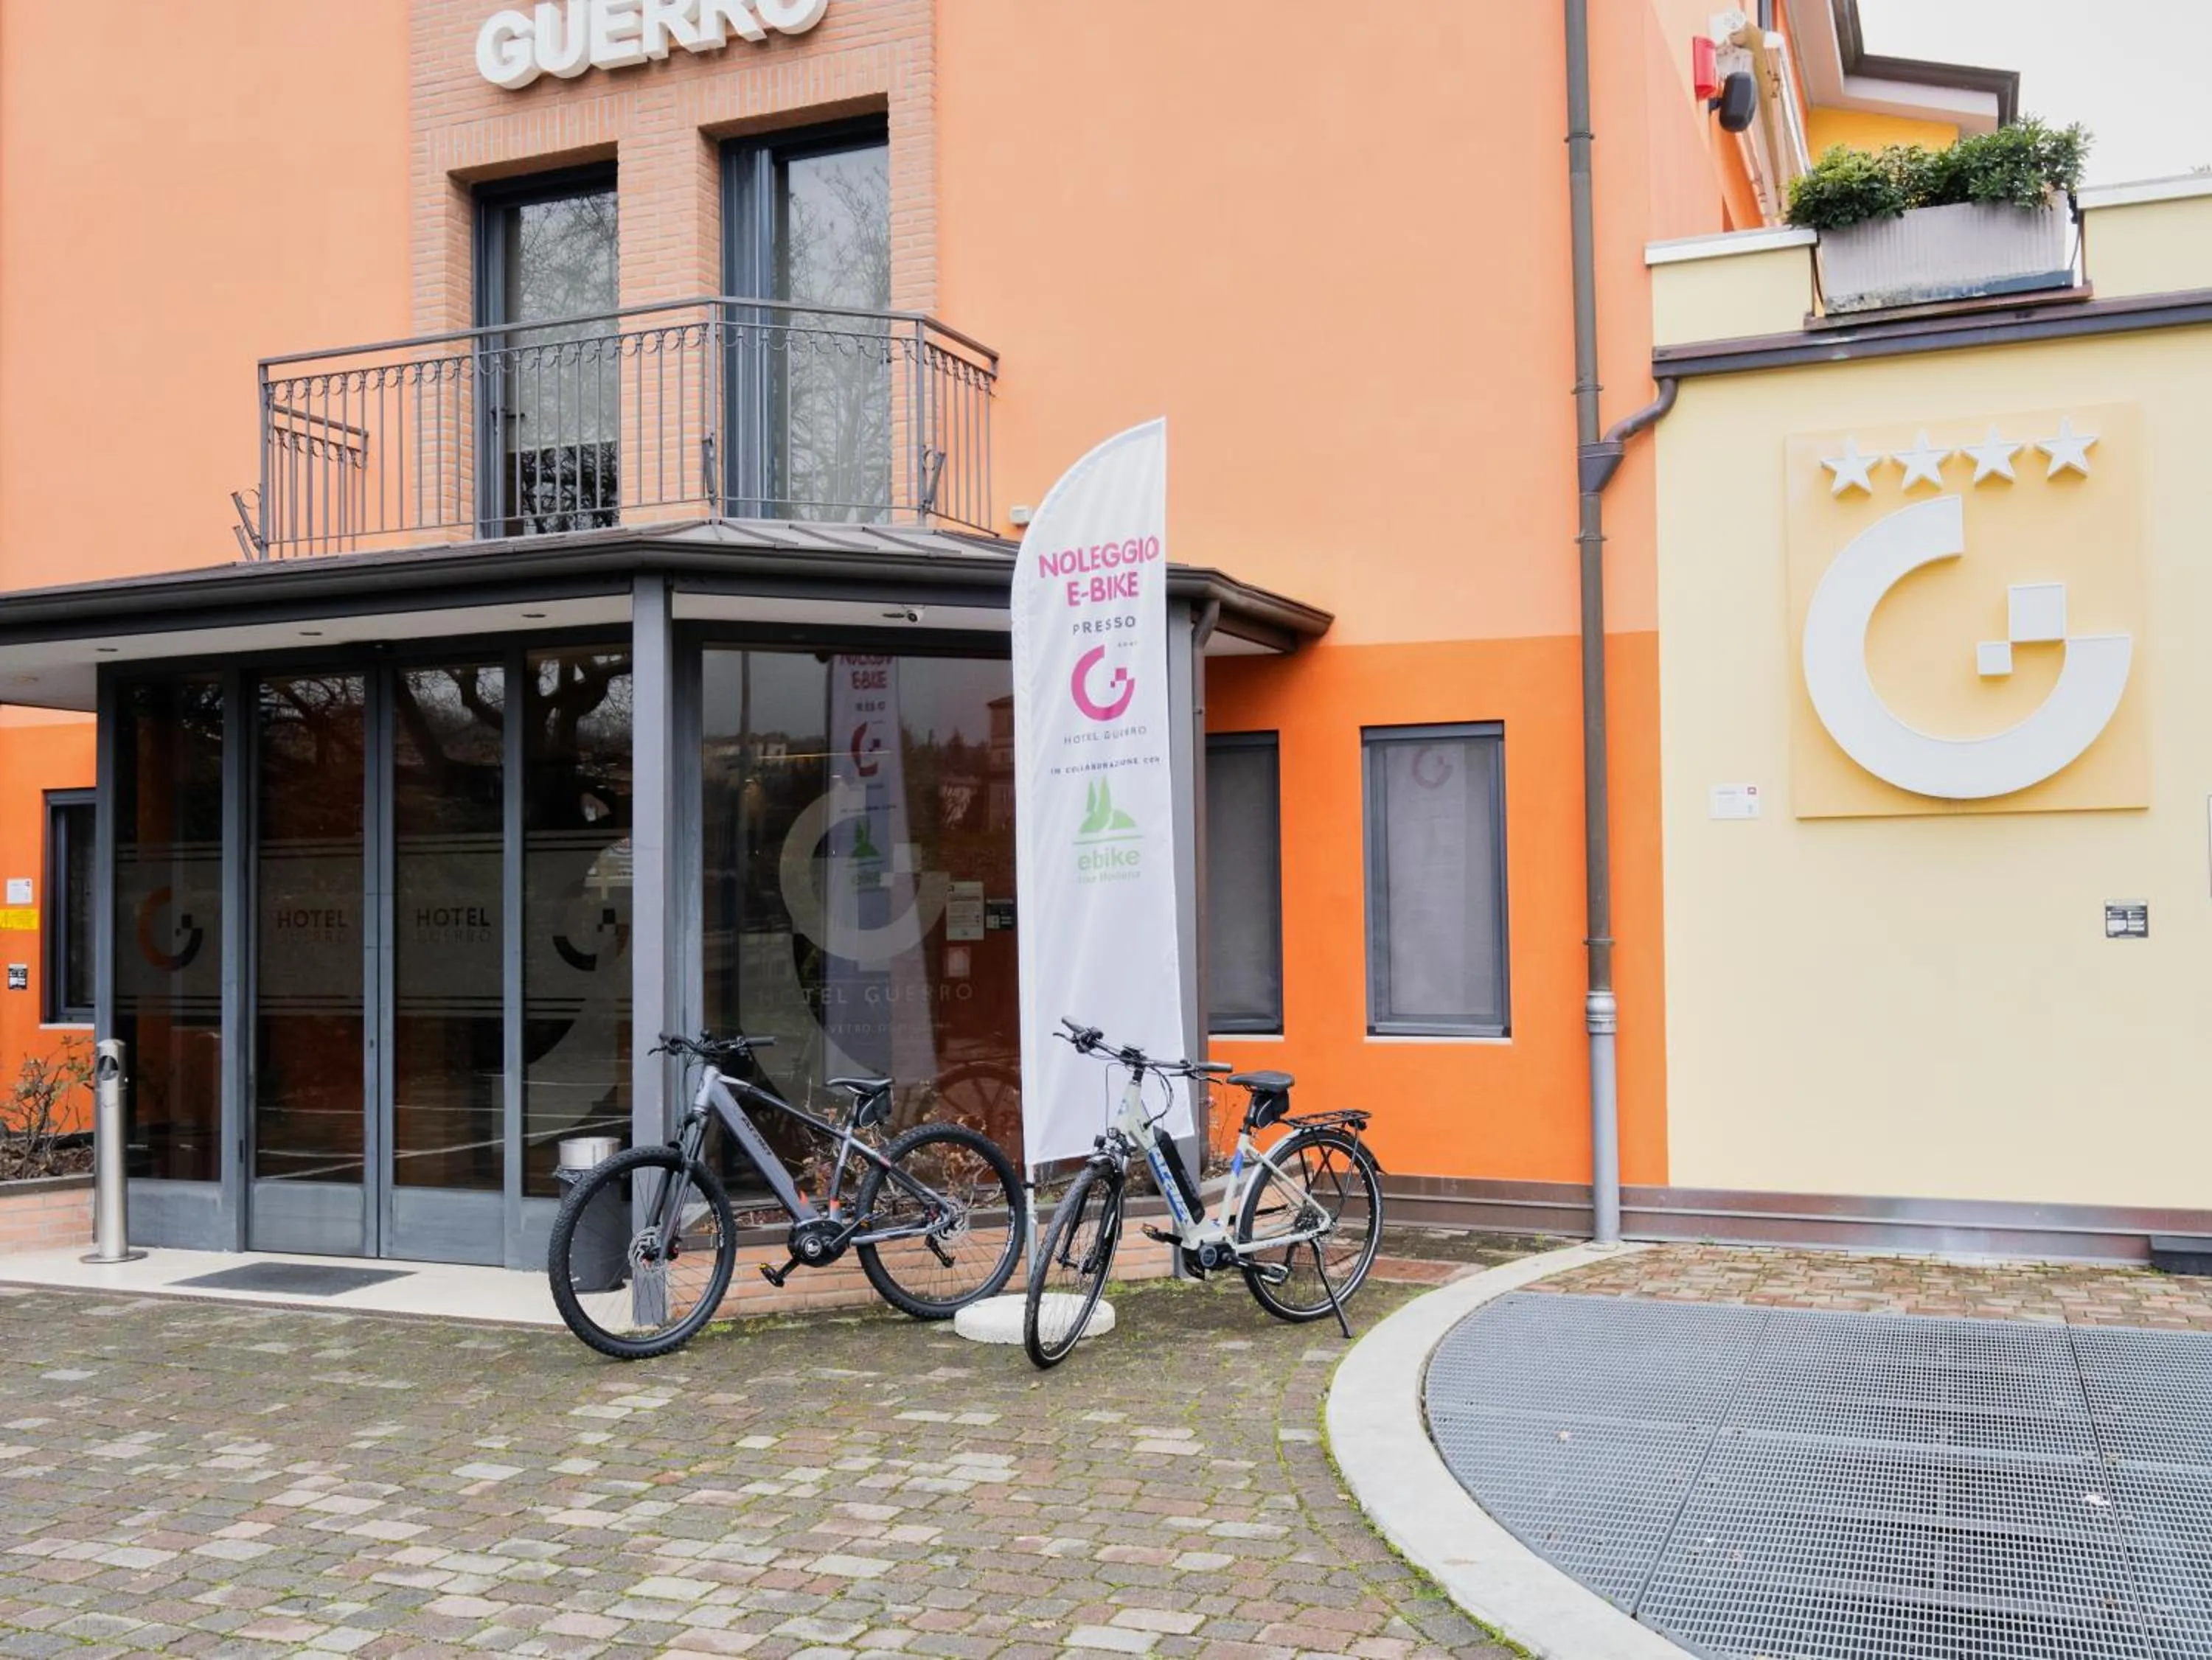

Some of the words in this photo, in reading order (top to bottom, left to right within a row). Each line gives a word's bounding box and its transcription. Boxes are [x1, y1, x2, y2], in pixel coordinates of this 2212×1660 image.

[1039, 534, 1160, 579] NOLEGGIO
[1067, 571, 1139, 607] E-BIKE
[1073, 615, 1136, 635] PRESSO
[1064, 732, 1099, 744] HOTEL
[1077, 845, 1141, 871] ebike
[277, 909, 348, 929] HOTEL
[417, 907, 491, 927] HOTEL
